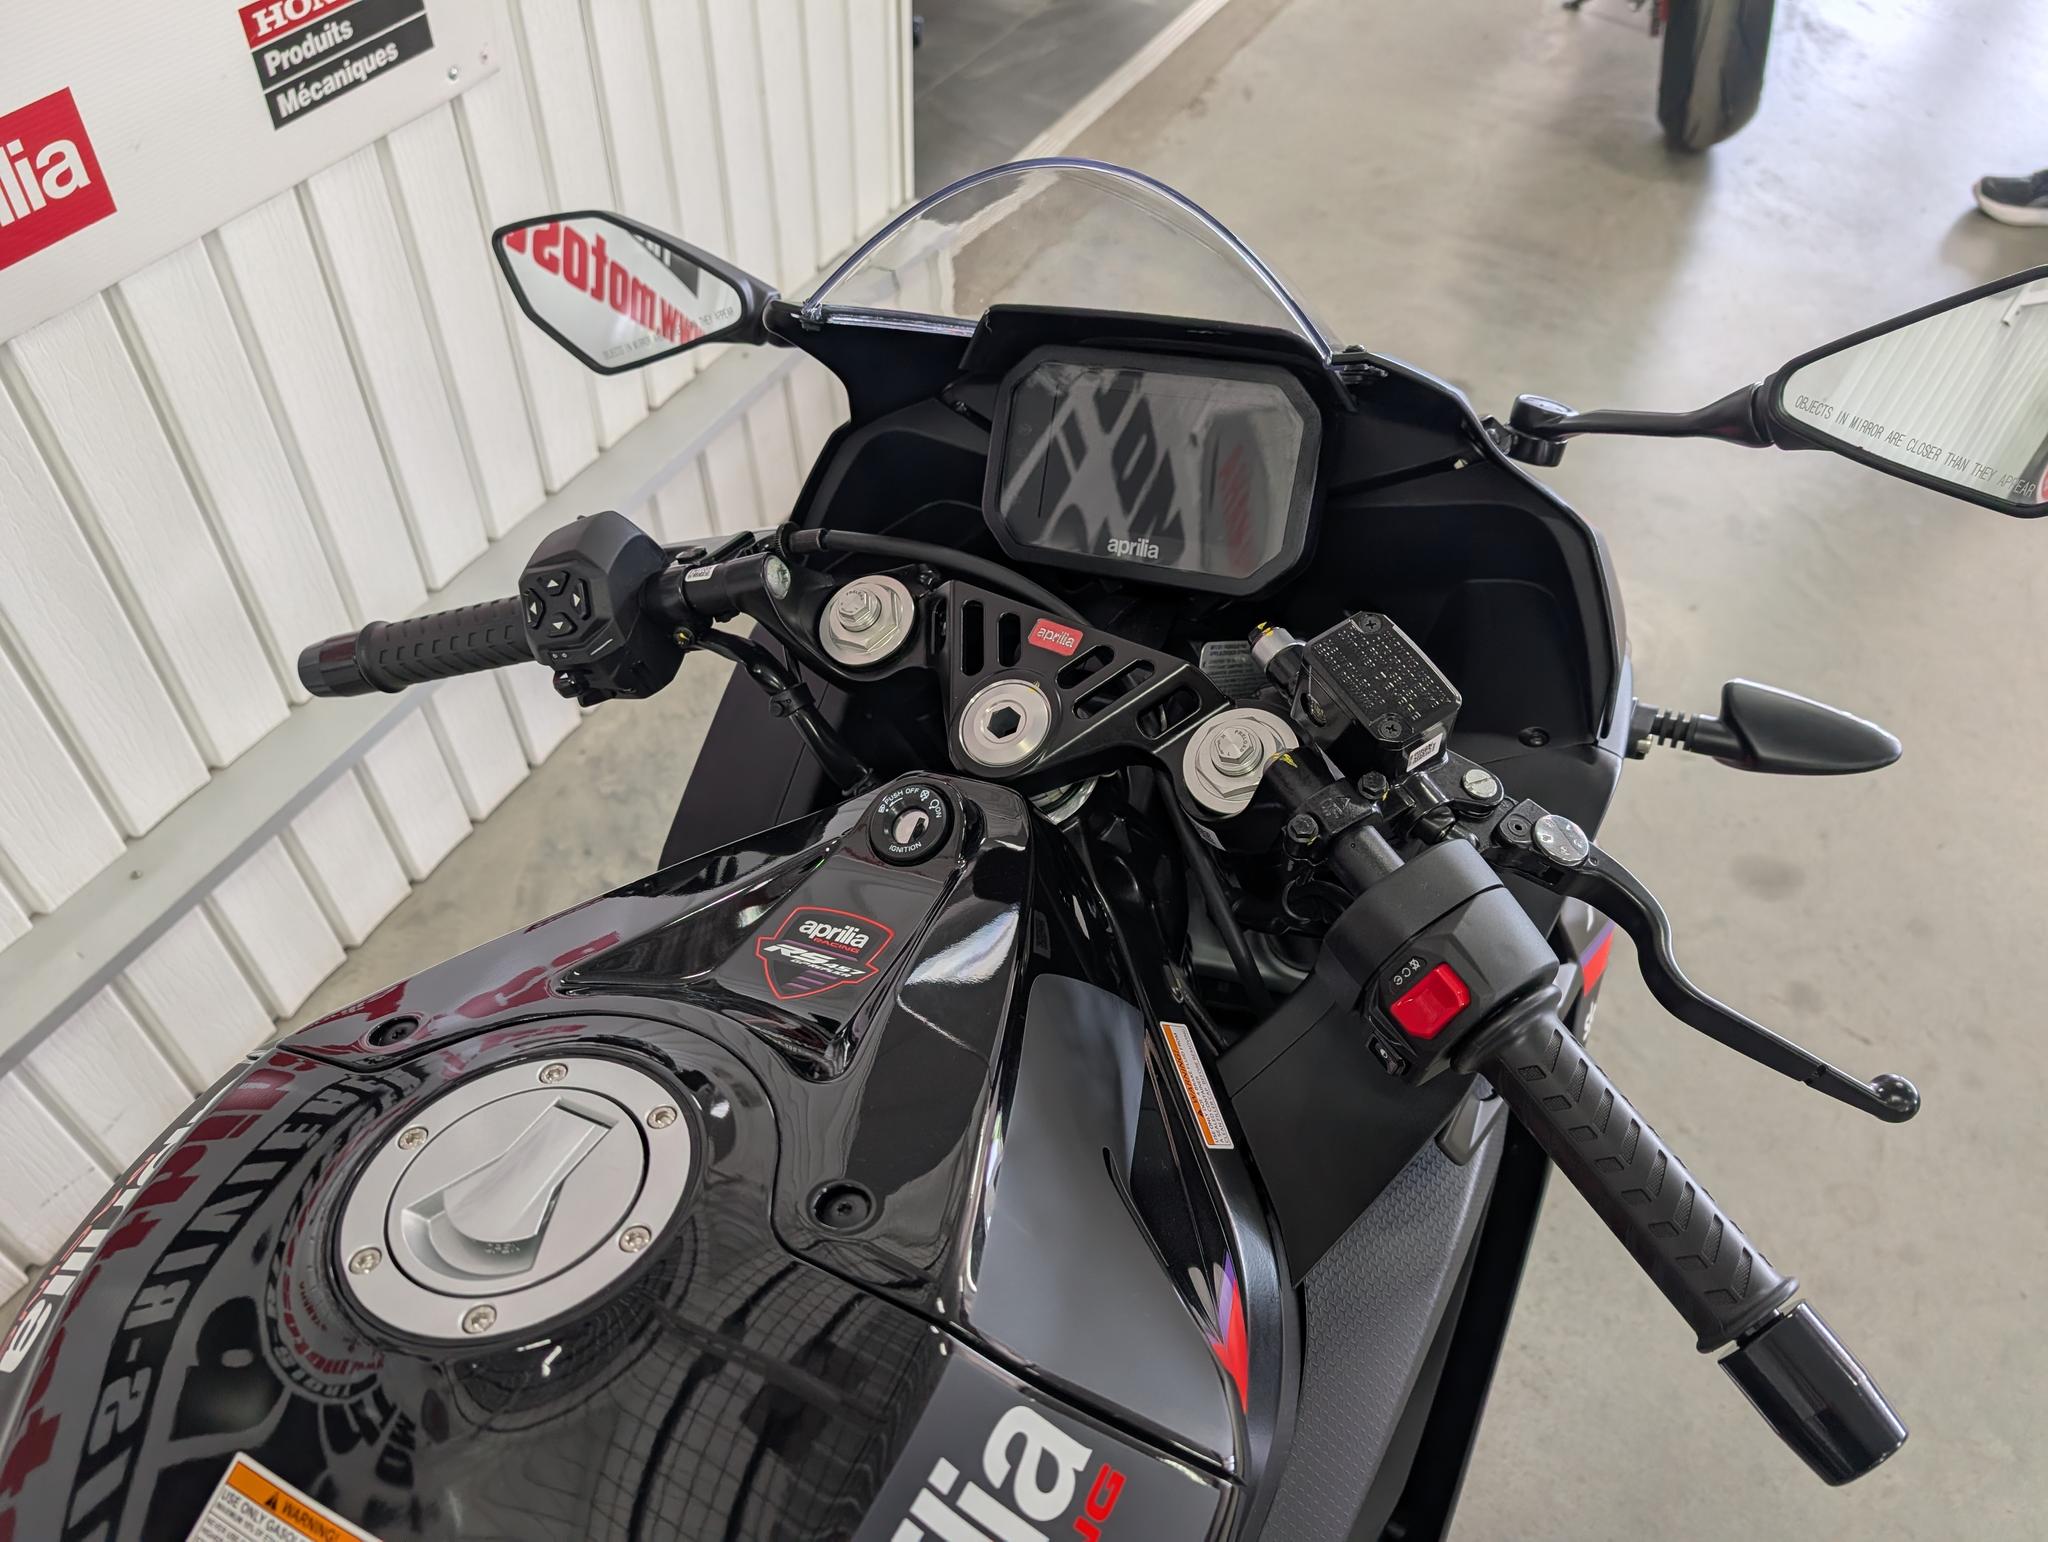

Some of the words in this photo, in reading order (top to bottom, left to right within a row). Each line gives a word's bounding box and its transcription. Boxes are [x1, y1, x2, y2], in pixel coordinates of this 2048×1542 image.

[264, 20, 354, 77] Produits
[276, 42, 399, 119] Mécaniques
[1795, 395, 1834, 419] OBJECTS
[1835, 410, 1849, 425] IN
[1850, 416, 1884, 439] MIRROR
[1885, 431, 1906, 447] ARE
[1906, 439, 1942, 462] CLOSER
[1944, 452, 1969, 472] THAN
[1971, 462, 1998, 481] THEY
[1999, 473, 2036, 497] APPEAR
[1107, 538, 1159, 559] aprilia
[1037, 627, 1075, 648] aprilia
[884, 790, 904, 805] PUSH
[935, 806, 942, 818] ON
[889, 841, 922, 853] IGNITION
[799, 920, 870, 949] aprilia
[813, 937, 861, 954] RACING
[221, 1488, 240, 1510] USE
[240, 1501, 265, 1526] ONLY
[282, 1502, 341, 1542] WARNING!
